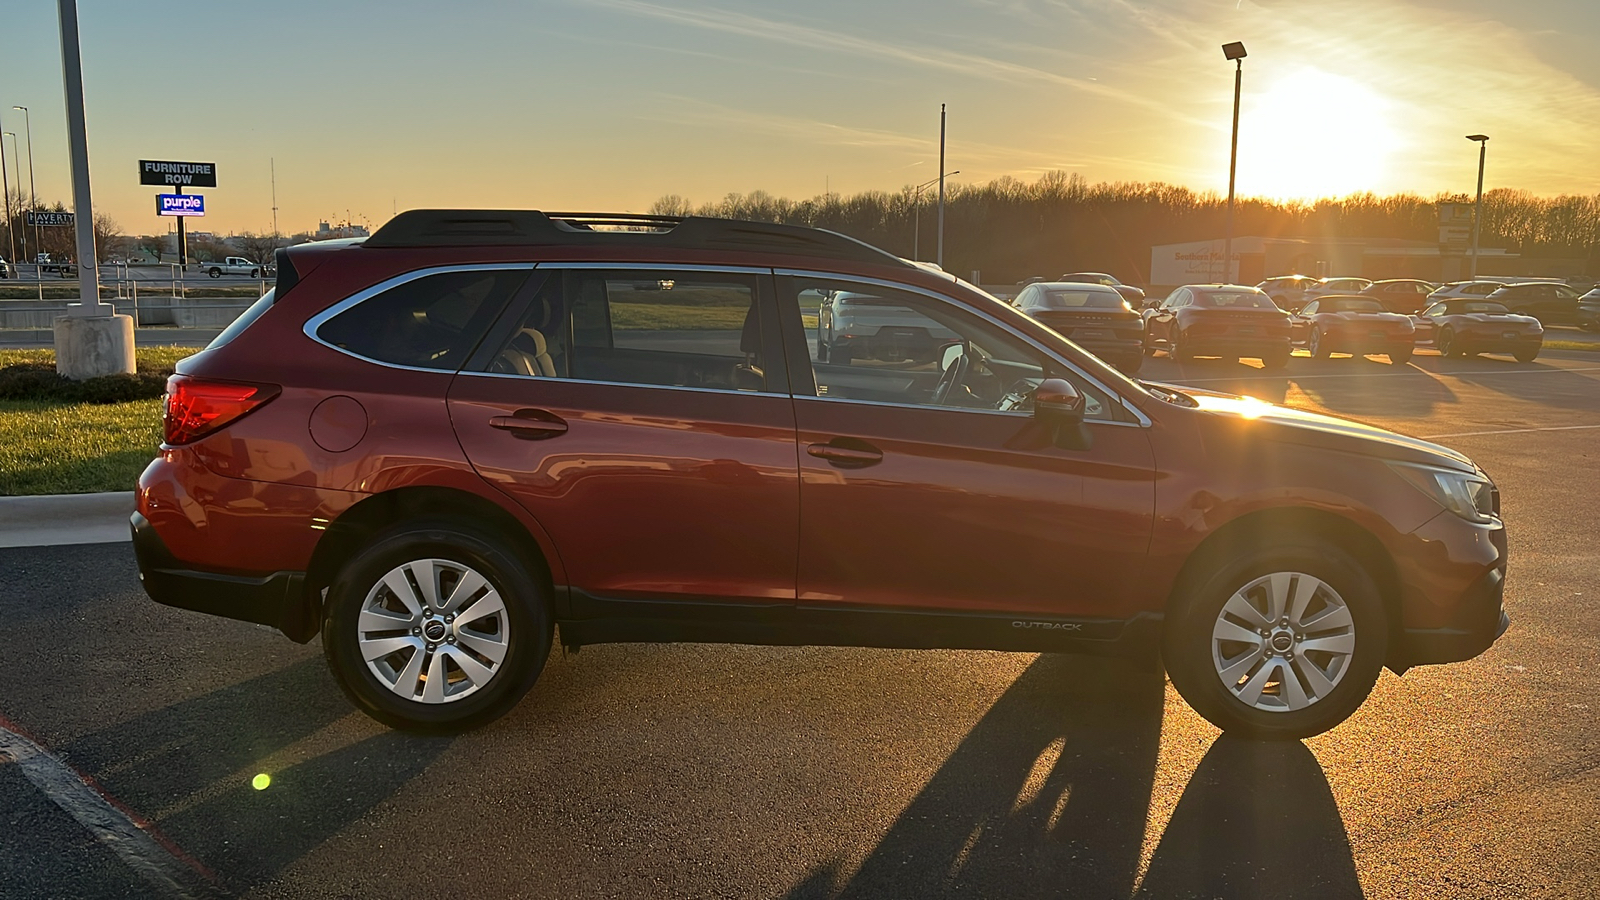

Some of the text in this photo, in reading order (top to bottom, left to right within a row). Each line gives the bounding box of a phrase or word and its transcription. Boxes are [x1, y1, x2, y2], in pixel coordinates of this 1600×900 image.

[144, 162, 211, 174] FURNITURE
[164, 174, 193, 184] ROW
[163, 195, 201, 209] purple
[1175, 252, 1209, 260] Southern
[1012, 621, 1082, 631] OUTBACK
